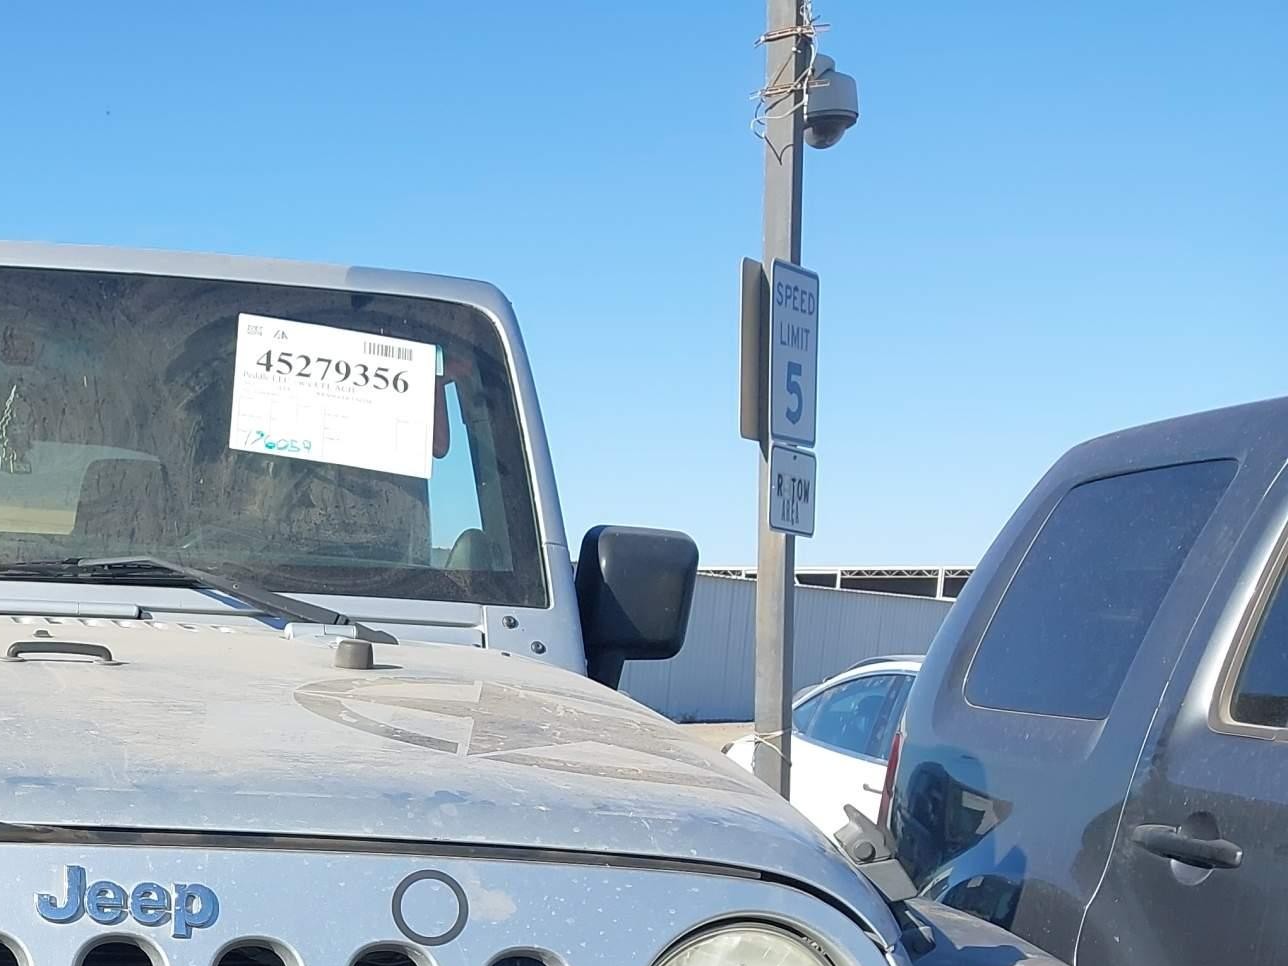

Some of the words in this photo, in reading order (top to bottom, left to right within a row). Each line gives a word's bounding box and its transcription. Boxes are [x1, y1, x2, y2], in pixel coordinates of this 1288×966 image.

[775, 281, 816, 316] SPEED
[779, 325, 811, 352] LIMIT
[256, 348, 410, 394] 45279356
[785, 360, 804, 426] 5
[33, 864, 220, 938] Jeep
